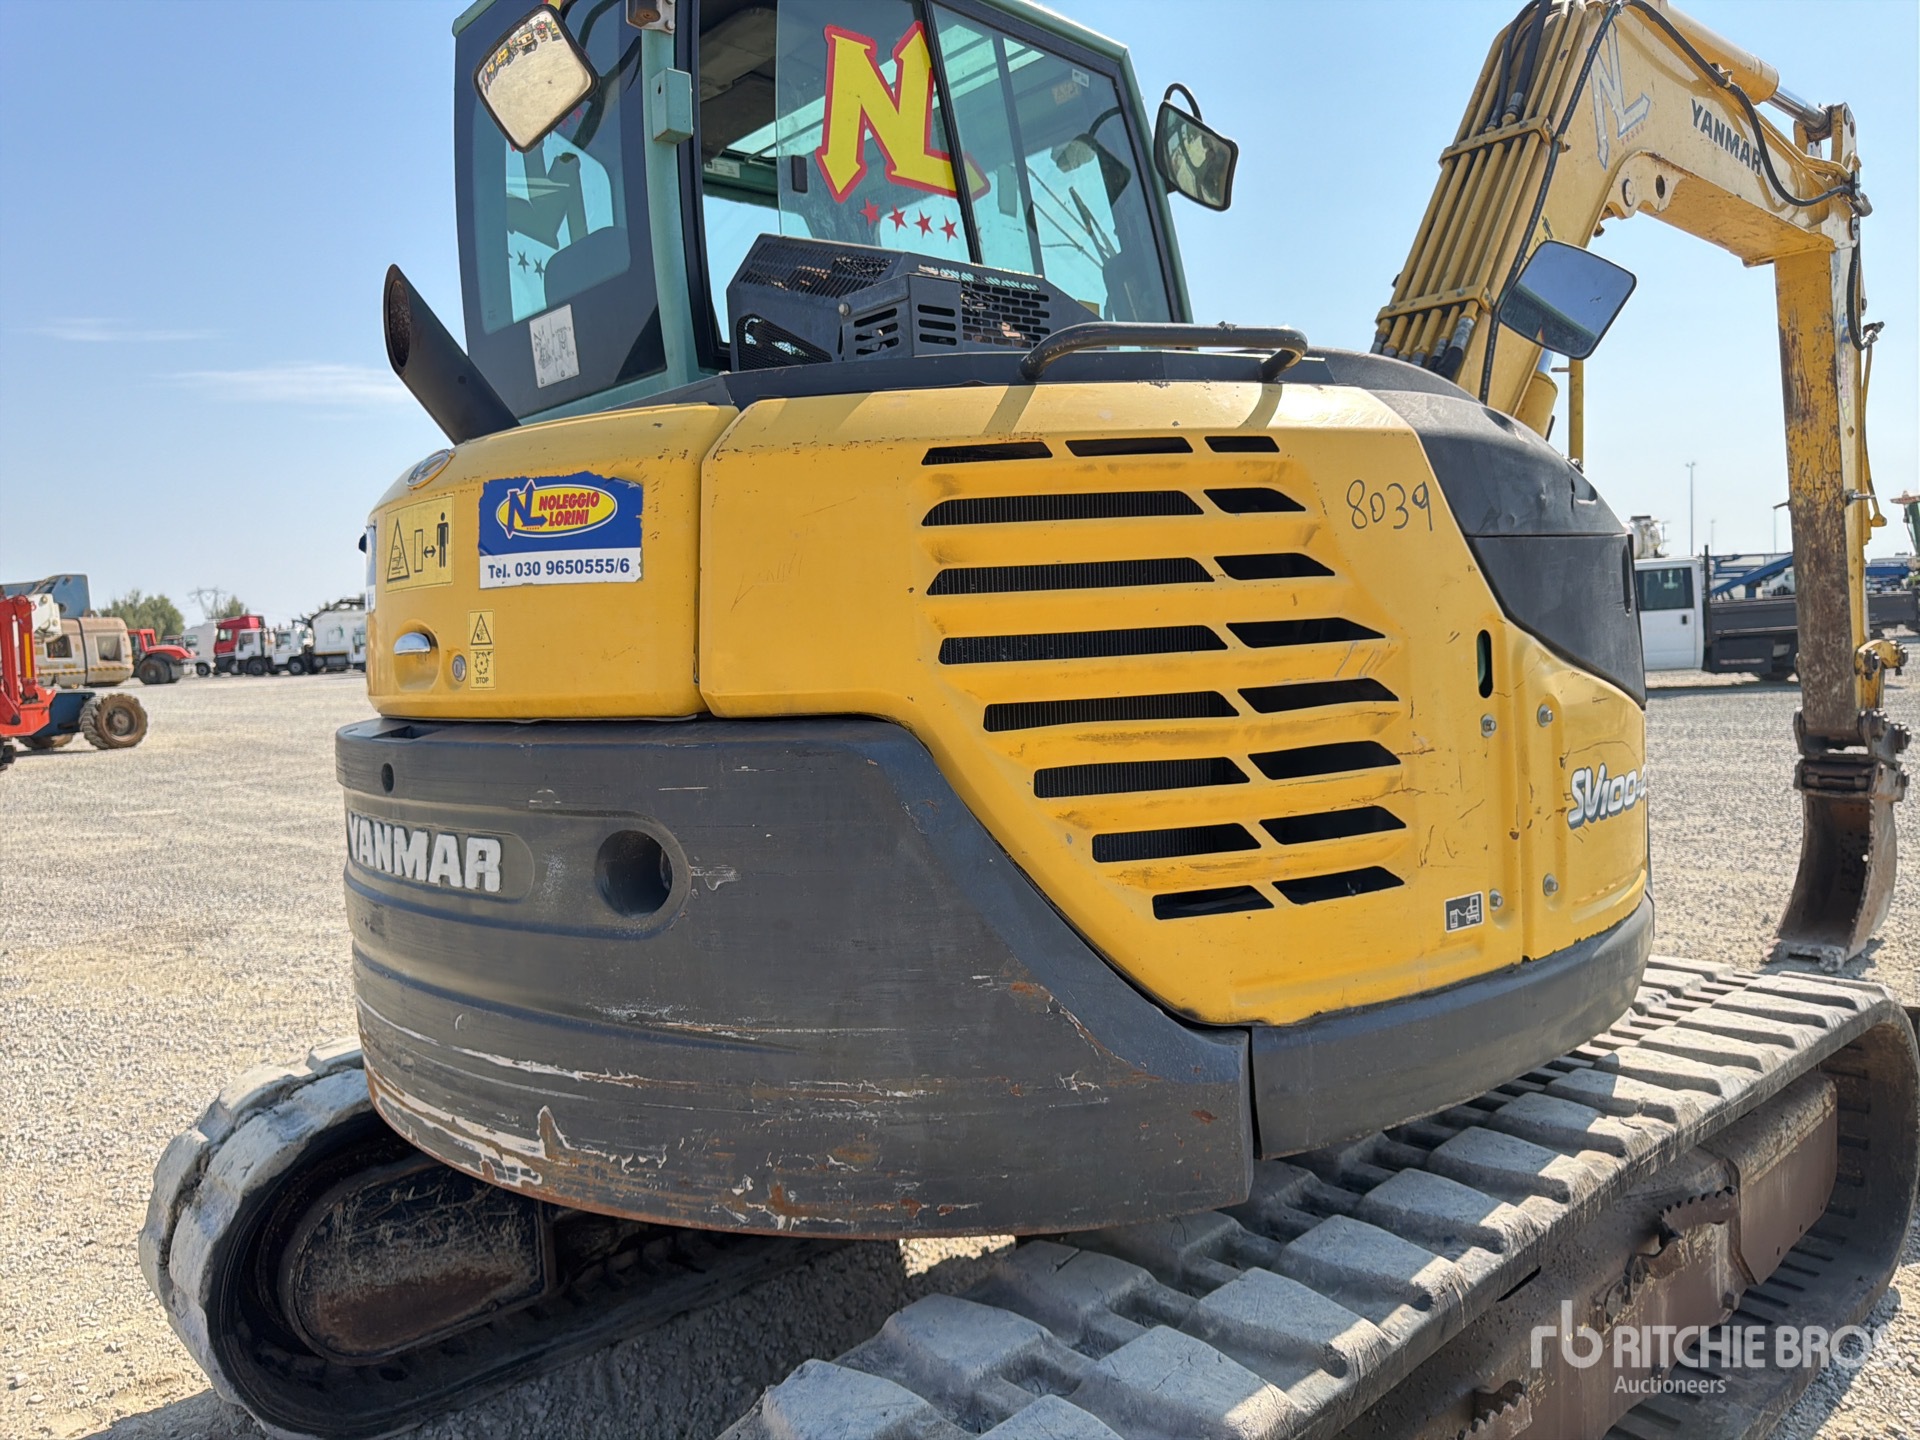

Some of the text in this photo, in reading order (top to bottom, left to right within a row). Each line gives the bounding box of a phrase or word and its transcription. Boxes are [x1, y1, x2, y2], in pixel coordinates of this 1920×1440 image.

[1691, 98, 1763, 176] YANMAR
[538, 491, 600, 511] NOLEGGIO
[548, 509, 590, 527] LORINI
[1346, 479, 1433, 532] 8039
[488, 558, 630, 579] Tel. 030 9650555/6
[348, 810, 502, 893] YANMAR
